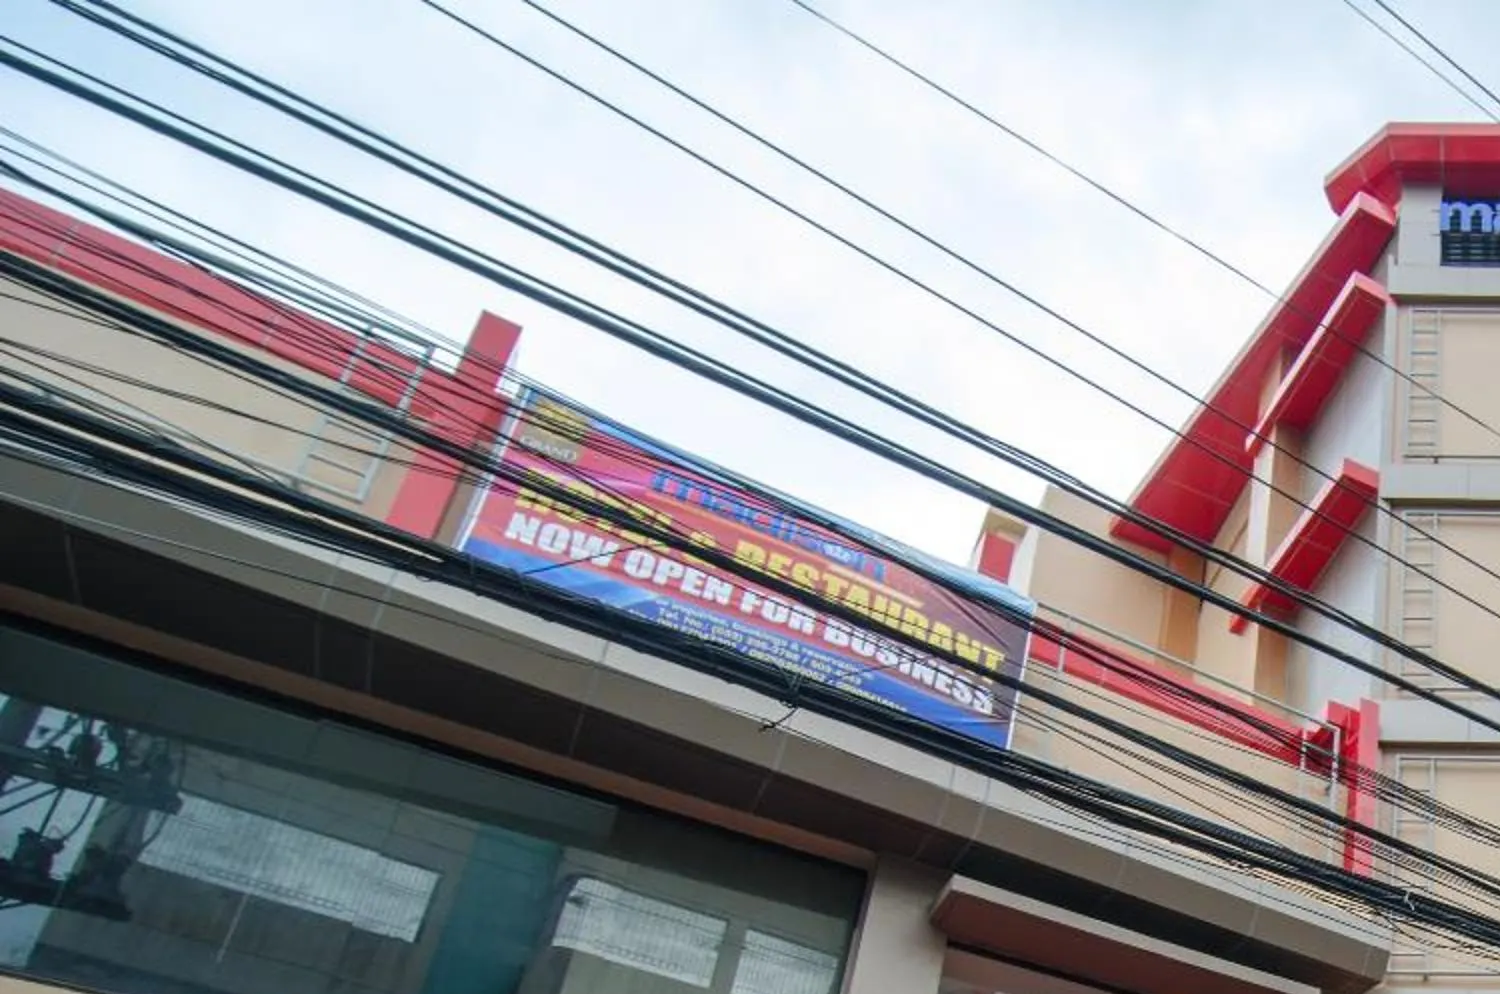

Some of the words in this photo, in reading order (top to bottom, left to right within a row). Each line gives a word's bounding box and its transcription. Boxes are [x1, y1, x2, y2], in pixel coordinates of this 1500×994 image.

[504, 511, 620, 568] NOW
[623, 546, 733, 606] OPEN
[740, 587, 817, 635] FOR
[823, 615, 994, 716] BUSINESS
[733, 538, 1006, 684] RESTAURANT
